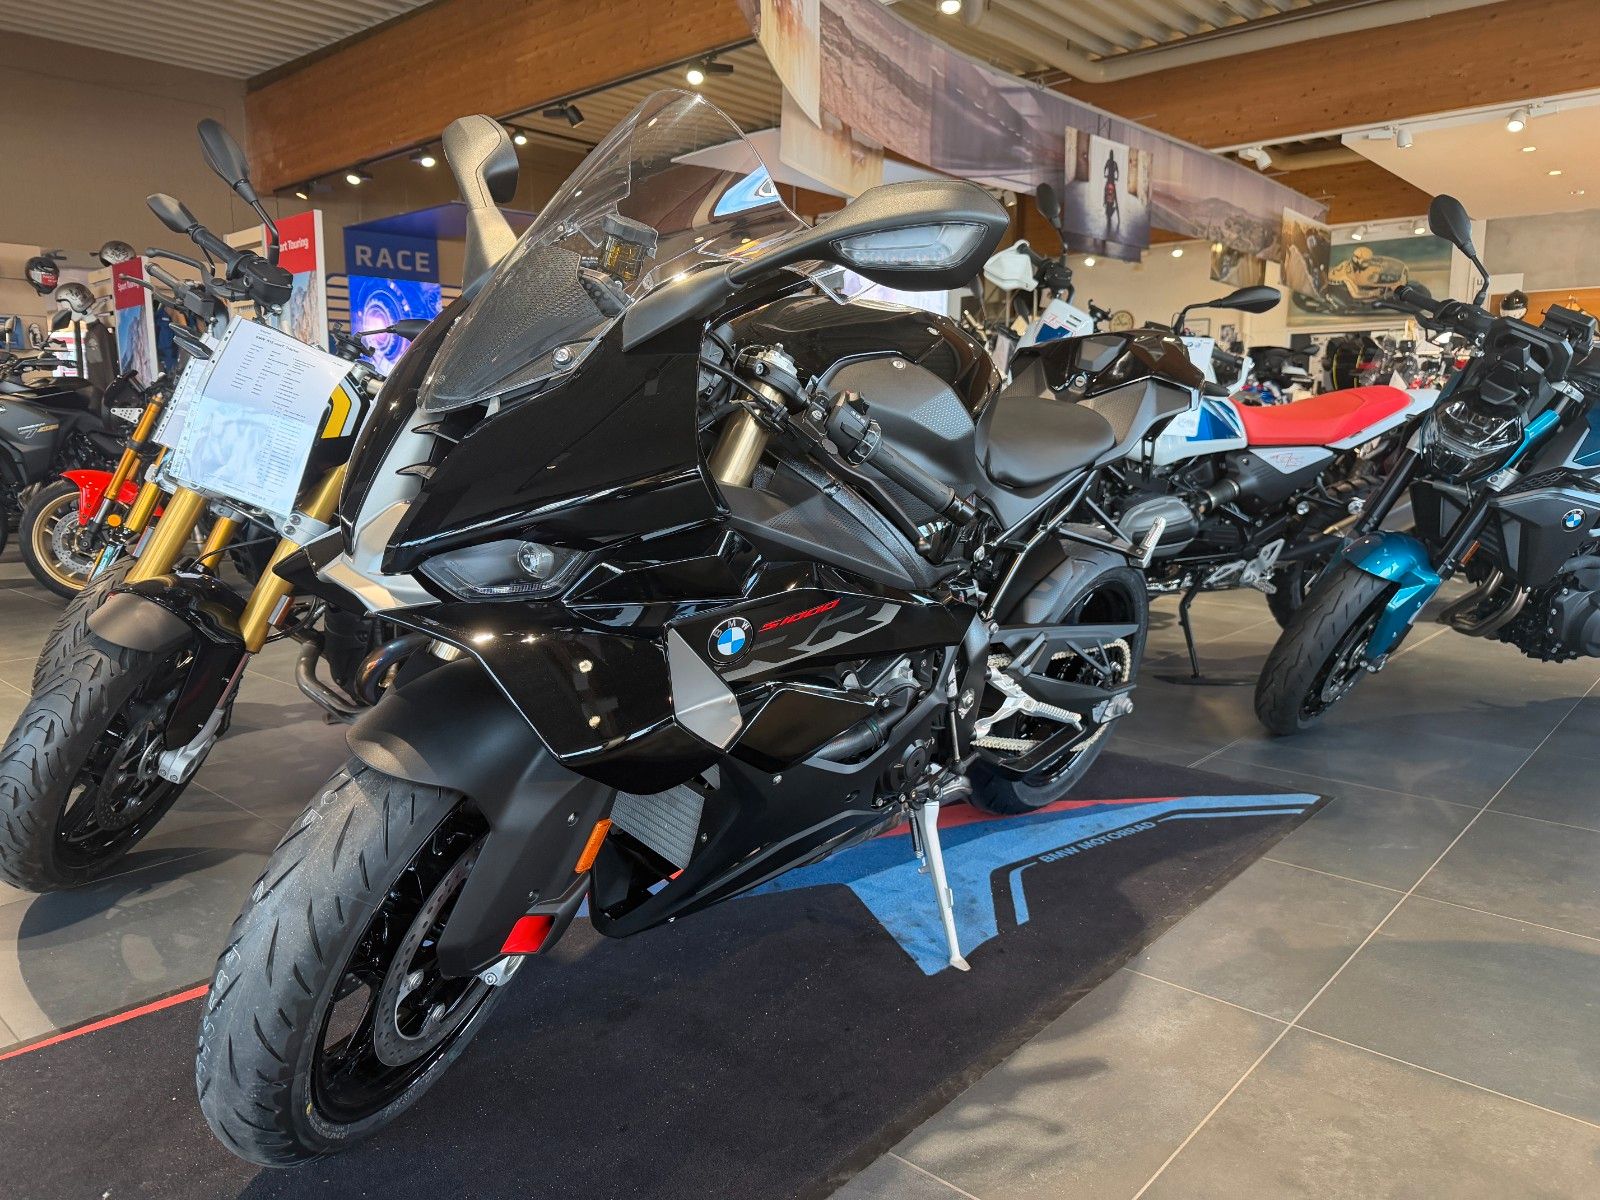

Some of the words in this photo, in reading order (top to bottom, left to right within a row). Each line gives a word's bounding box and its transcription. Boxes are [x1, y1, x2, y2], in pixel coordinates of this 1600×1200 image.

[355, 244, 431, 273] RACE
[758, 598, 842, 633] S1000
[1039, 846, 1081, 863] BMW
[1078, 821, 1157, 850] MOTORRAD
